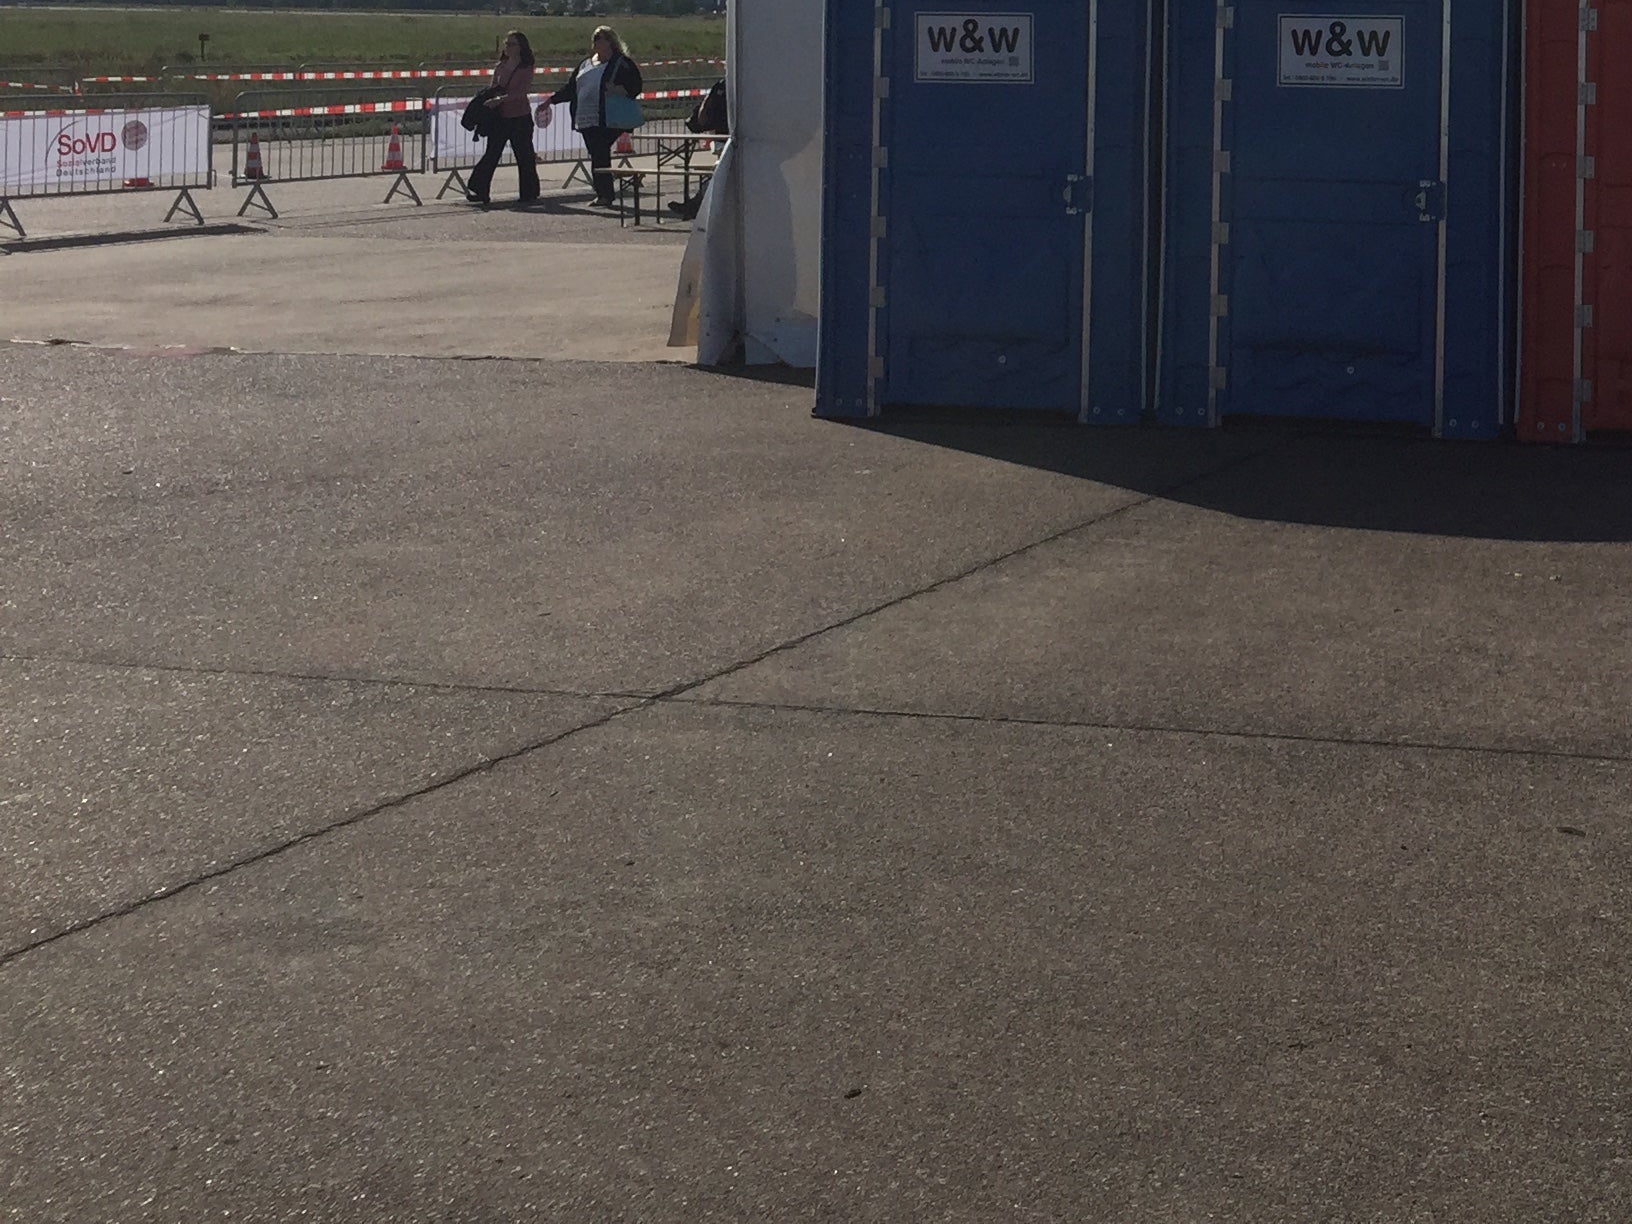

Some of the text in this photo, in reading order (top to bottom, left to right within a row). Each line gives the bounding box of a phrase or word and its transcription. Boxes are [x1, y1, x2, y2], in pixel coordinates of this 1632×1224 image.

[927, 18, 1020, 54] W&W
[1291, 21, 1391, 57] W&W
[57, 132, 116, 155] SoVD
[56, 157, 117, 168] Sozialverband
[56, 166, 117, 177] Deutschland
